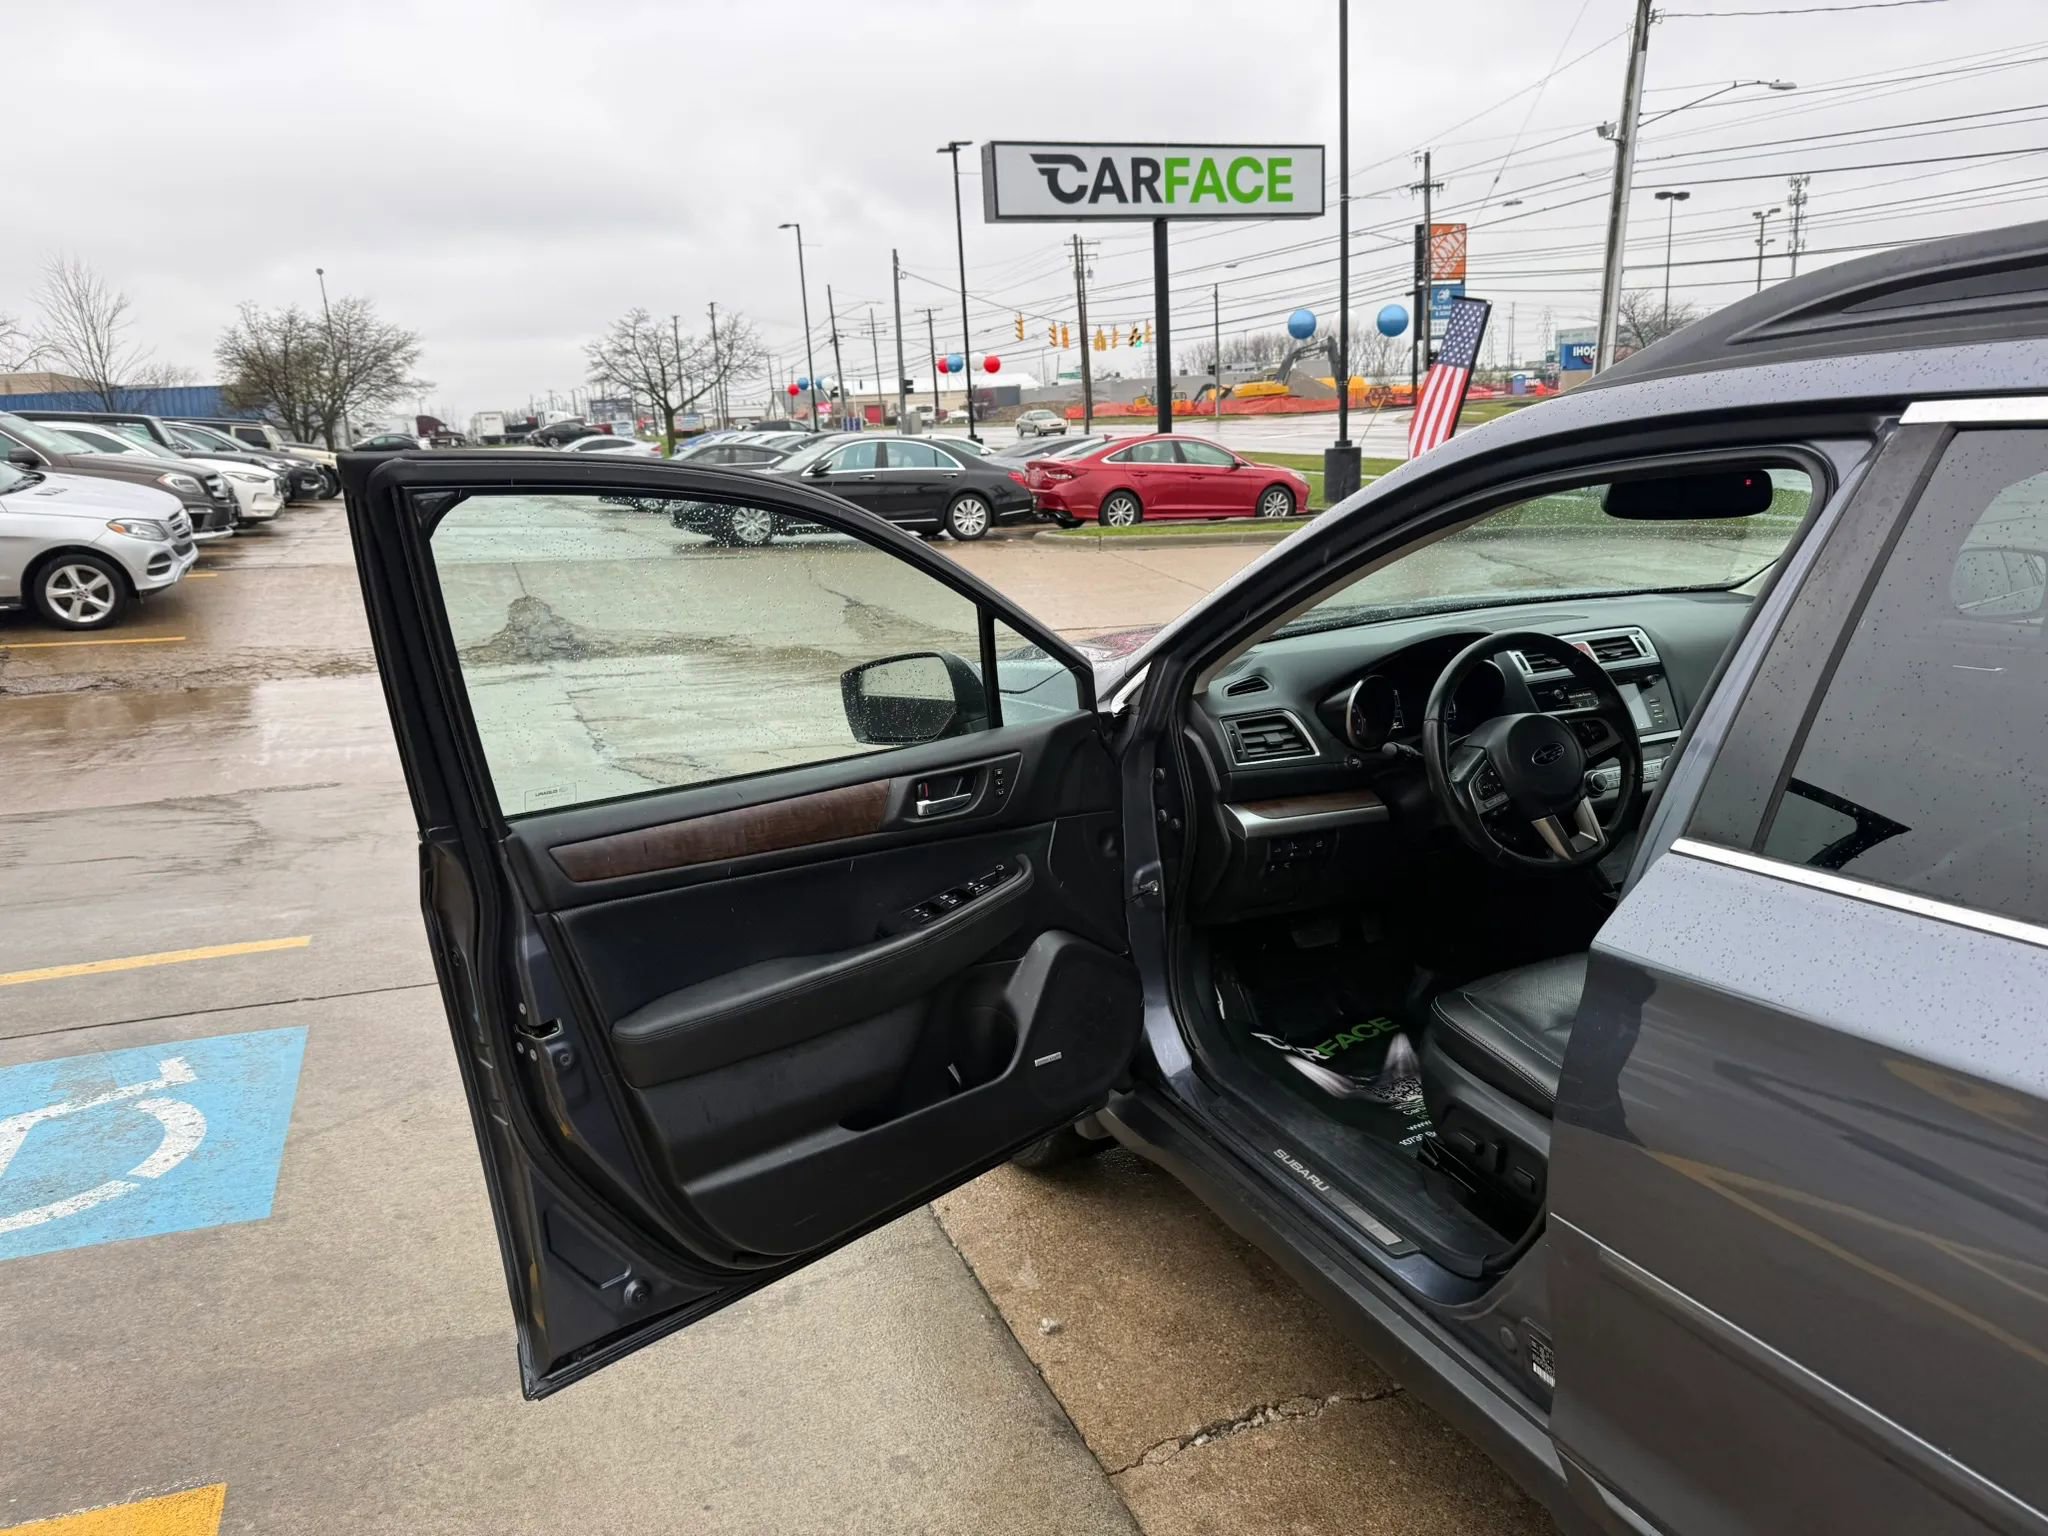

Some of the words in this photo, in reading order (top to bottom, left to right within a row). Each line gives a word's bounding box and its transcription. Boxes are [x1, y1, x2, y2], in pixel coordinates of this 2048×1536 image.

[1030, 153, 1294, 204] CARFACE
[1250, 1016, 1399, 1062] CRFACE
[1273, 1148, 1330, 1192] SUBARU
